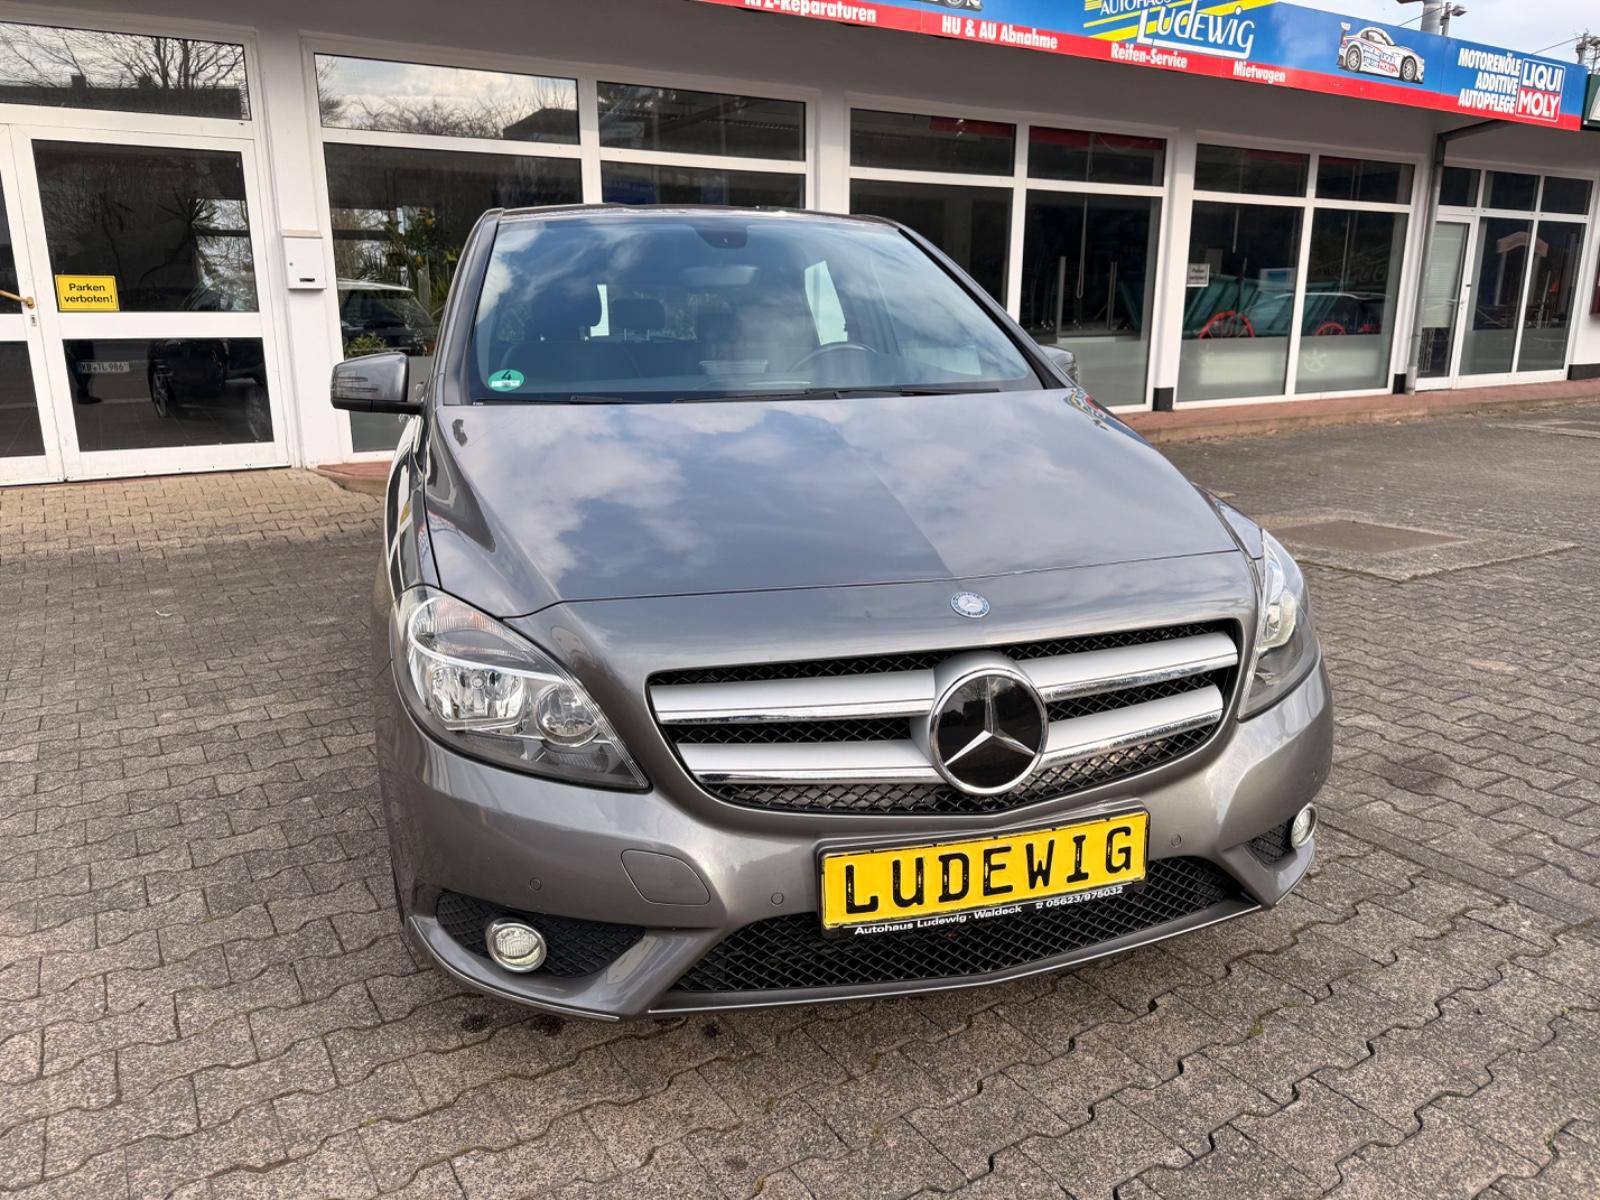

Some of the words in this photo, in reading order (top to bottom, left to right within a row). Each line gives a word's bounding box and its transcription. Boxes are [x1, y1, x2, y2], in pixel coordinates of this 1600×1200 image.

[744, 0, 877, 23] -Reparaturen
[1100, 0, 1171, 16] AUTOH
[941, 15, 961, 36] HU
[965, 19, 976, 38] &
[978, 21, 997, 41] AU
[999, 24, 1058, 50] Abnahme
[1111, 42, 1188, 69] Reifen-Service
[1458, 47, 1522, 76] MOTORENÖLE
[1233, 61, 1286, 84] Mietwagen
[1475, 72, 1519, 95] ADDITIVE
[1521, 65, 1562, 93] LIQUI
[1458, 89, 1516, 114] AUTOPFLEGE
[1518, 93, 1560, 118] MOLY
[64, 294, 113, 303] verboten!
[68, 282, 106, 292] Parken
[501, 370, 512, 381] 4
[844, 825, 1132, 915] LUDEWIG
[854, 921, 914, 936] Autohaus
[916, 914, 967, 930] Ludewig
[973, 905, 1023, 920] Waldeck
